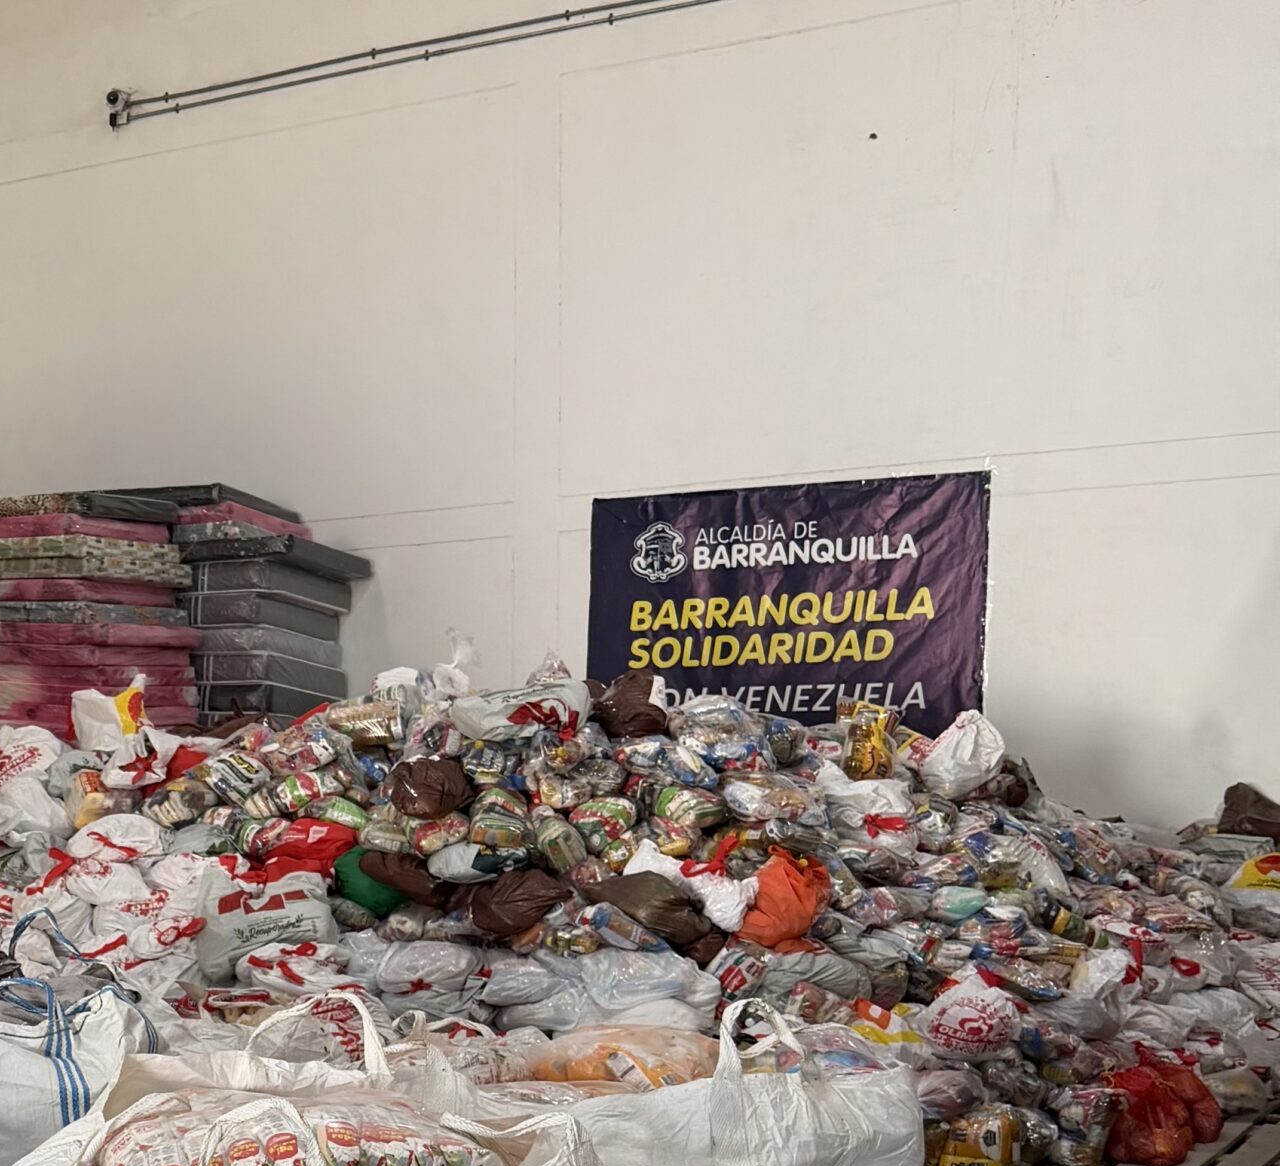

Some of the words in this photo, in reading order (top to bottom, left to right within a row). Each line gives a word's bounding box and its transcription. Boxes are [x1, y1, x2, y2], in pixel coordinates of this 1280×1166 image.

[693, 533, 919, 571] BARRANQUILLA
[695, 519, 786, 546] ALCALDÍA
[794, 521, 819, 539] DE
[630, 586, 935, 632] BARRANQUILLA
[628, 629, 894, 669] SOLIDARIDAD
